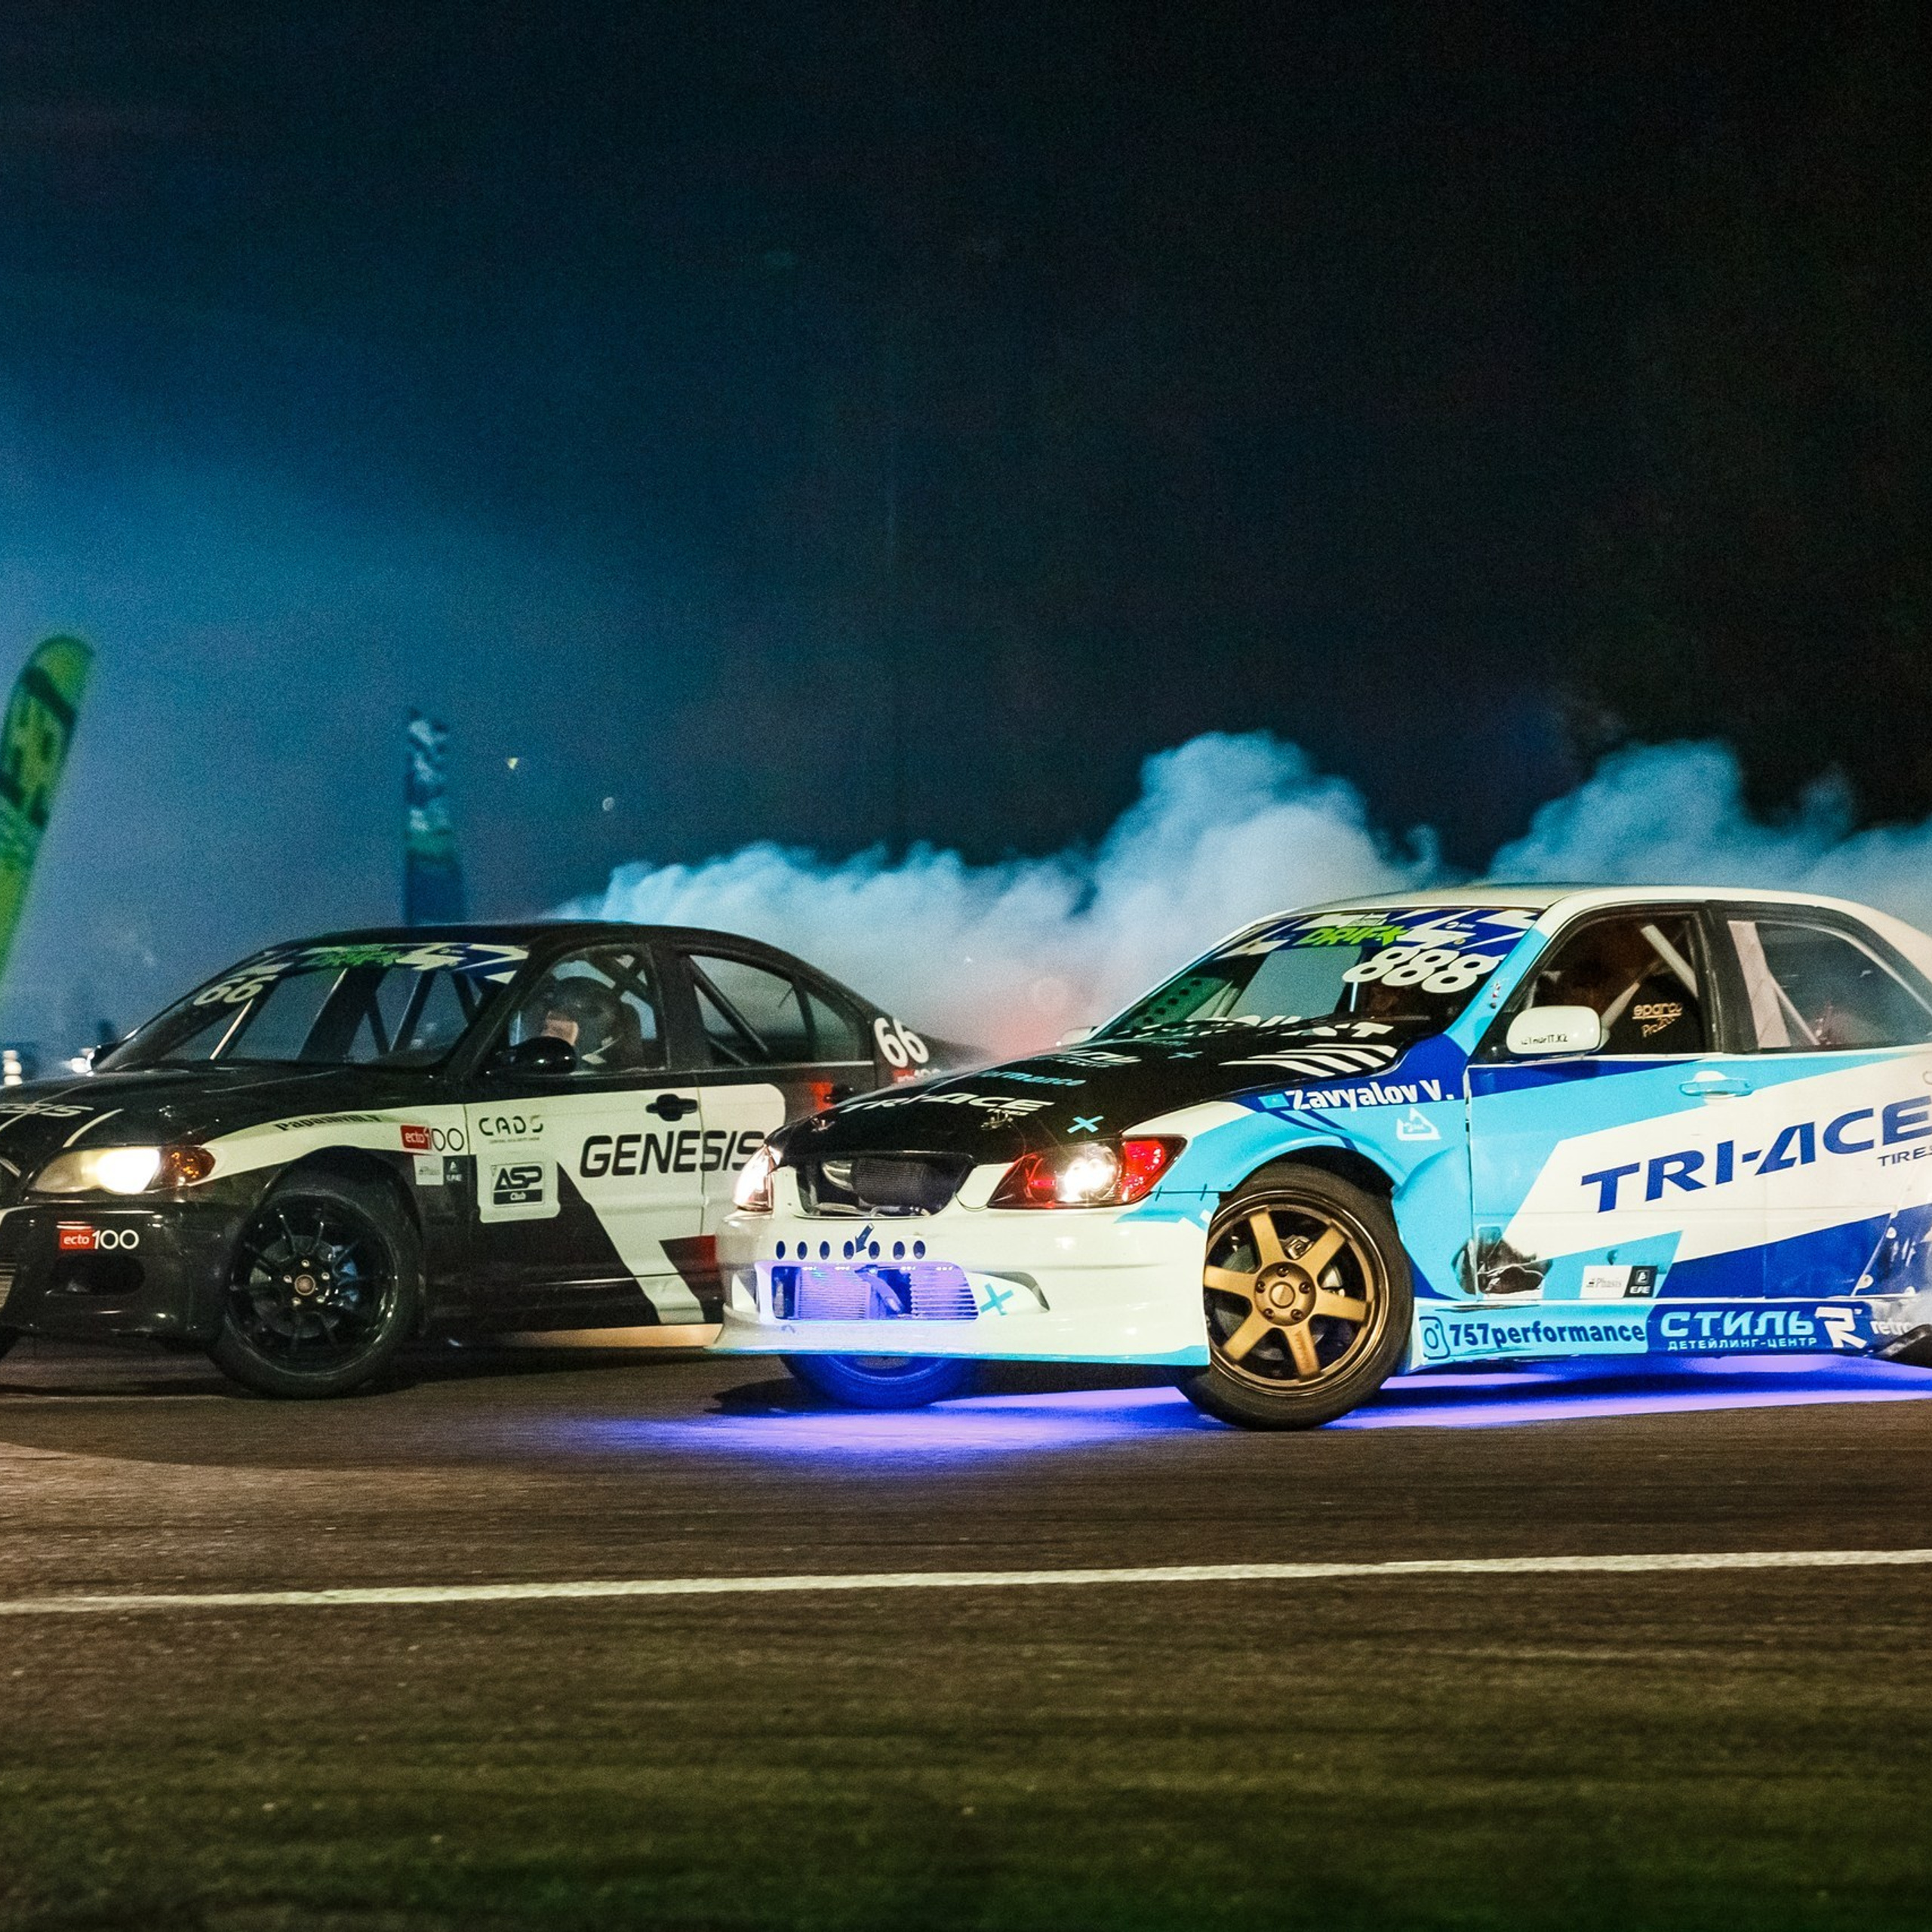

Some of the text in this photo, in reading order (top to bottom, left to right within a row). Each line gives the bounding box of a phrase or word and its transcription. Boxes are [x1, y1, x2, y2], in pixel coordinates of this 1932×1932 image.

[1342, 946, 1500, 994] 888
[192, 974, 279, 1006] 66
[874, 1017, 929, 1068] 66
[1285, 1079, 1454, 1112] Zavyalov V.
[579, 1130, 765, 1178] GENESIS
[1580, 1095, 1932, 1214] TRI-ACE
[494, 1165, 543, 1191] ASP
[1448, 1321, 1646, 1348] 757performance
[1660, 1311, 1814, 1337] СТИЛЬ
[1667, 1337, 1818, 1352] ДЕТЕЙЛИНГ-ЦЕНТР
